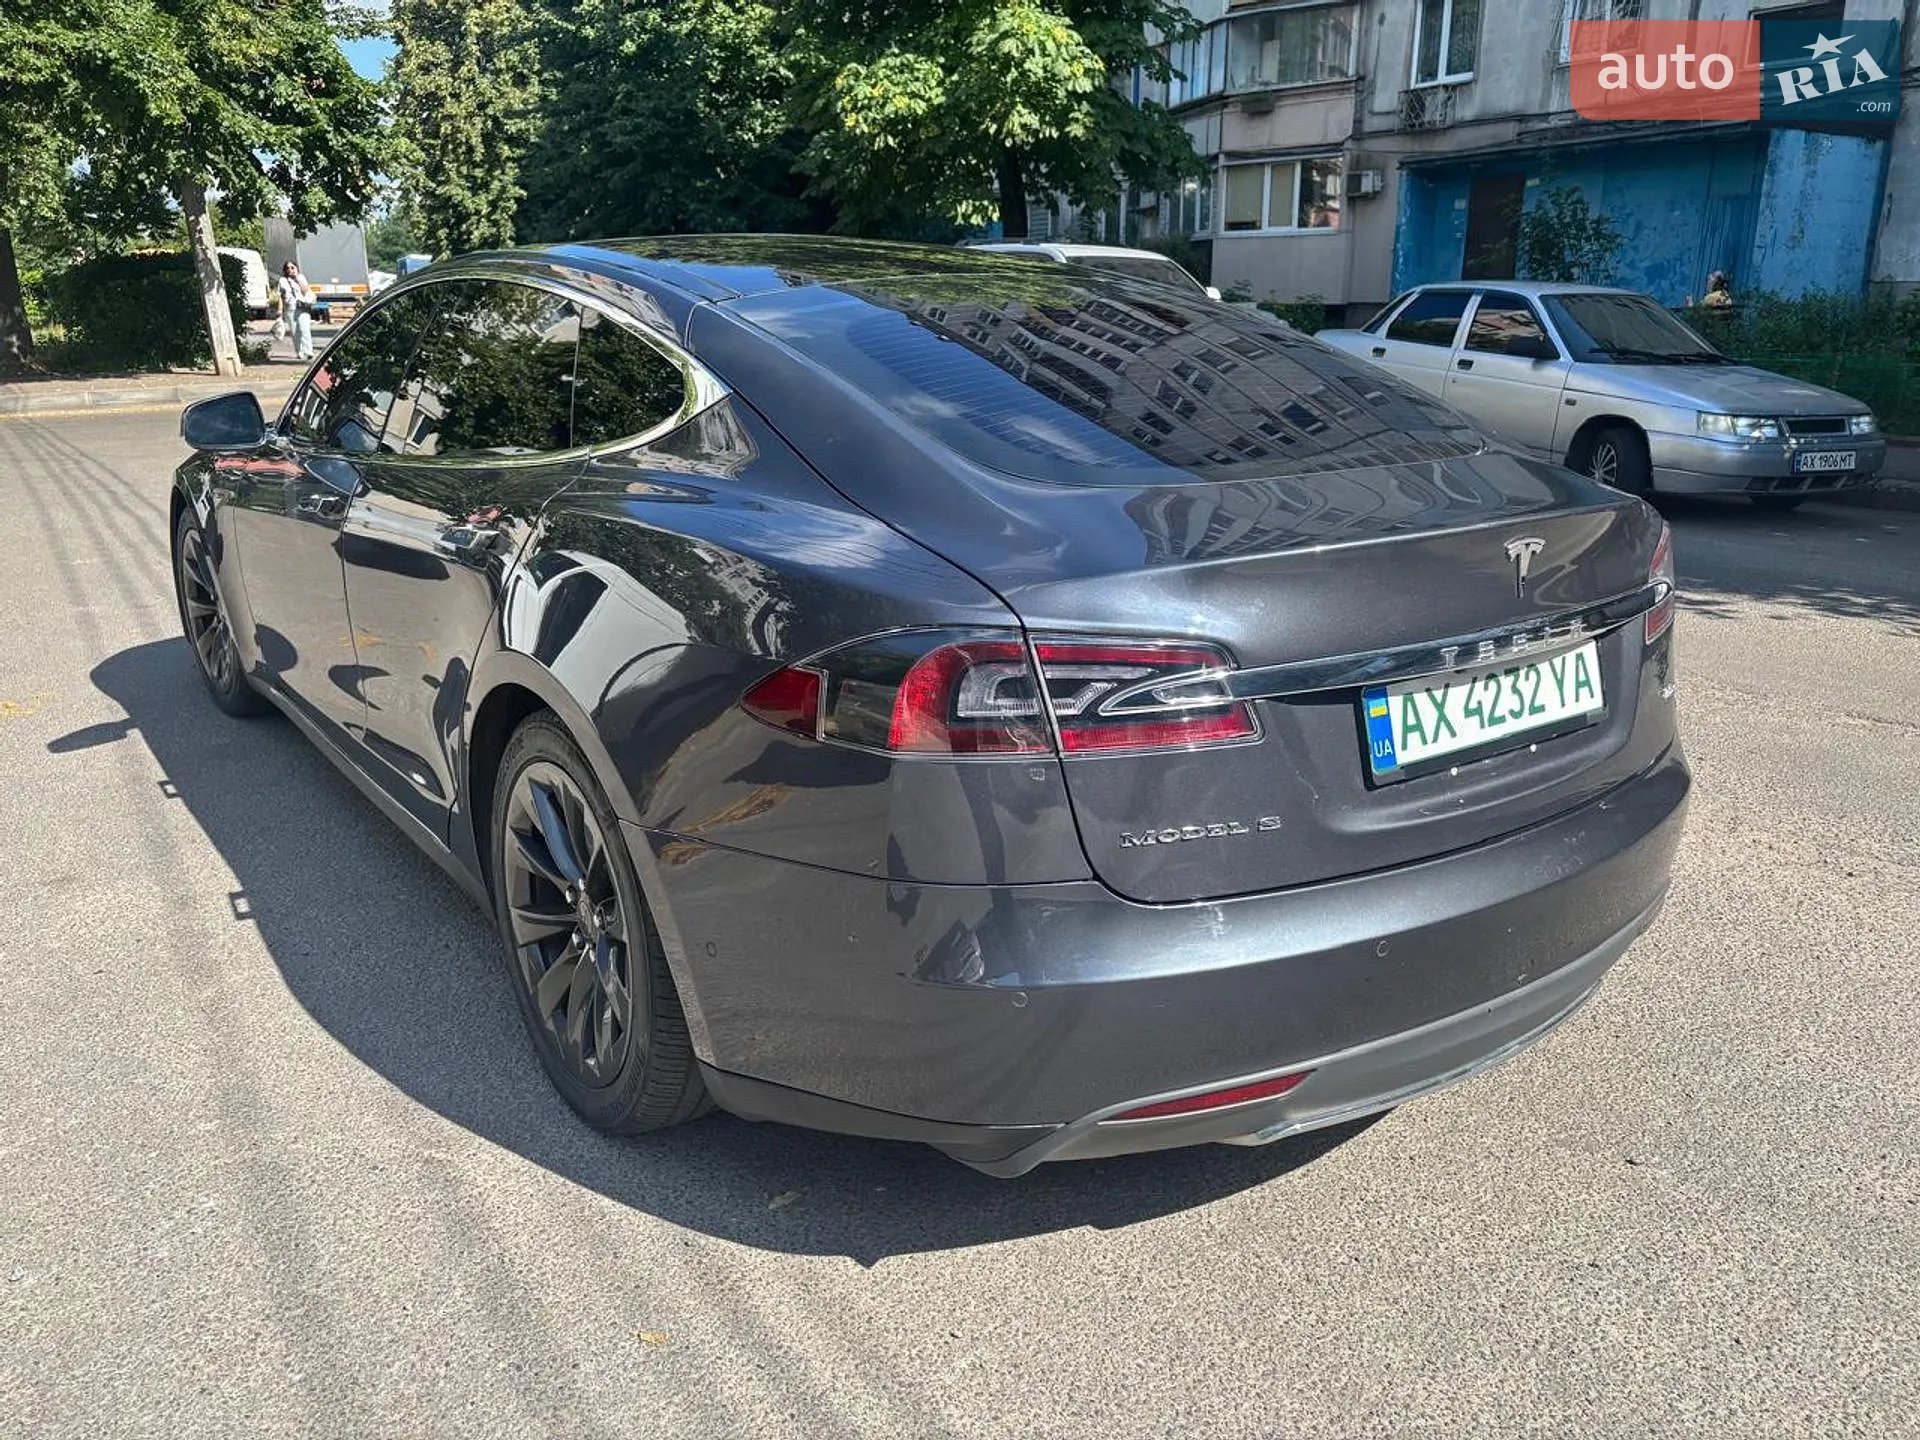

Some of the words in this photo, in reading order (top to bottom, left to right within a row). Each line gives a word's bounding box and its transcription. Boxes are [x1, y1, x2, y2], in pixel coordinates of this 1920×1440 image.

[1802, 455, 1816, 469] AX
[1819, 454, 1839, 468] 1906
[1840, 453, 1853, 468] MT
[1400, 683, 1458, 752] AX
[1463, 663, 1547, 731] 4232
[1549, 651, 1596, 709] YA
[1373, 738, 1394, 758] UA
[1119, 821, 1249, 848] MODEL
[1258, 815, 1282, 832] S
